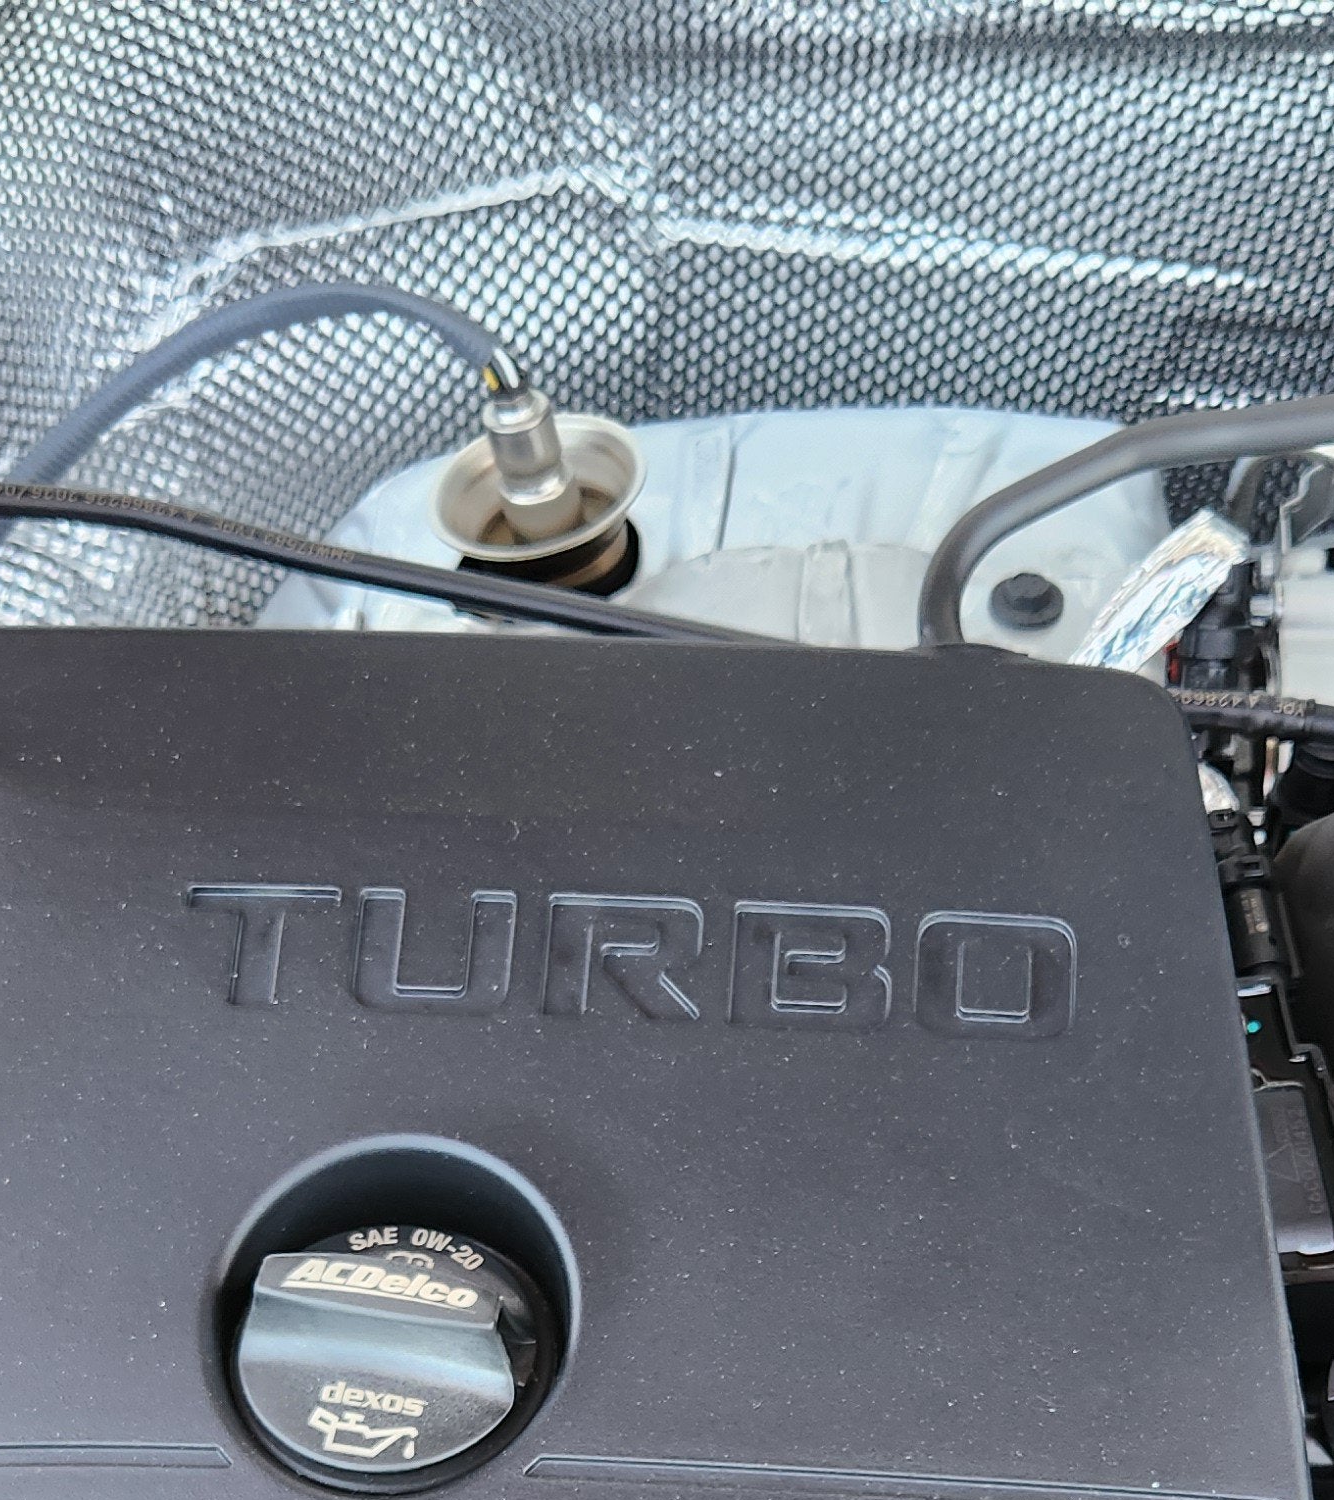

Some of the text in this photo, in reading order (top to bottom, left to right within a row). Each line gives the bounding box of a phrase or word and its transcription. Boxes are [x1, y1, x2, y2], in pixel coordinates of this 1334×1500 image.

[185, 884, 1079, 1036] TURBO
[349, 1226, 485, 1271] SAE 0W-20
[286, 1258, 479, 1309] ACDelco
[320, 1381, 428, 1418] dexos
